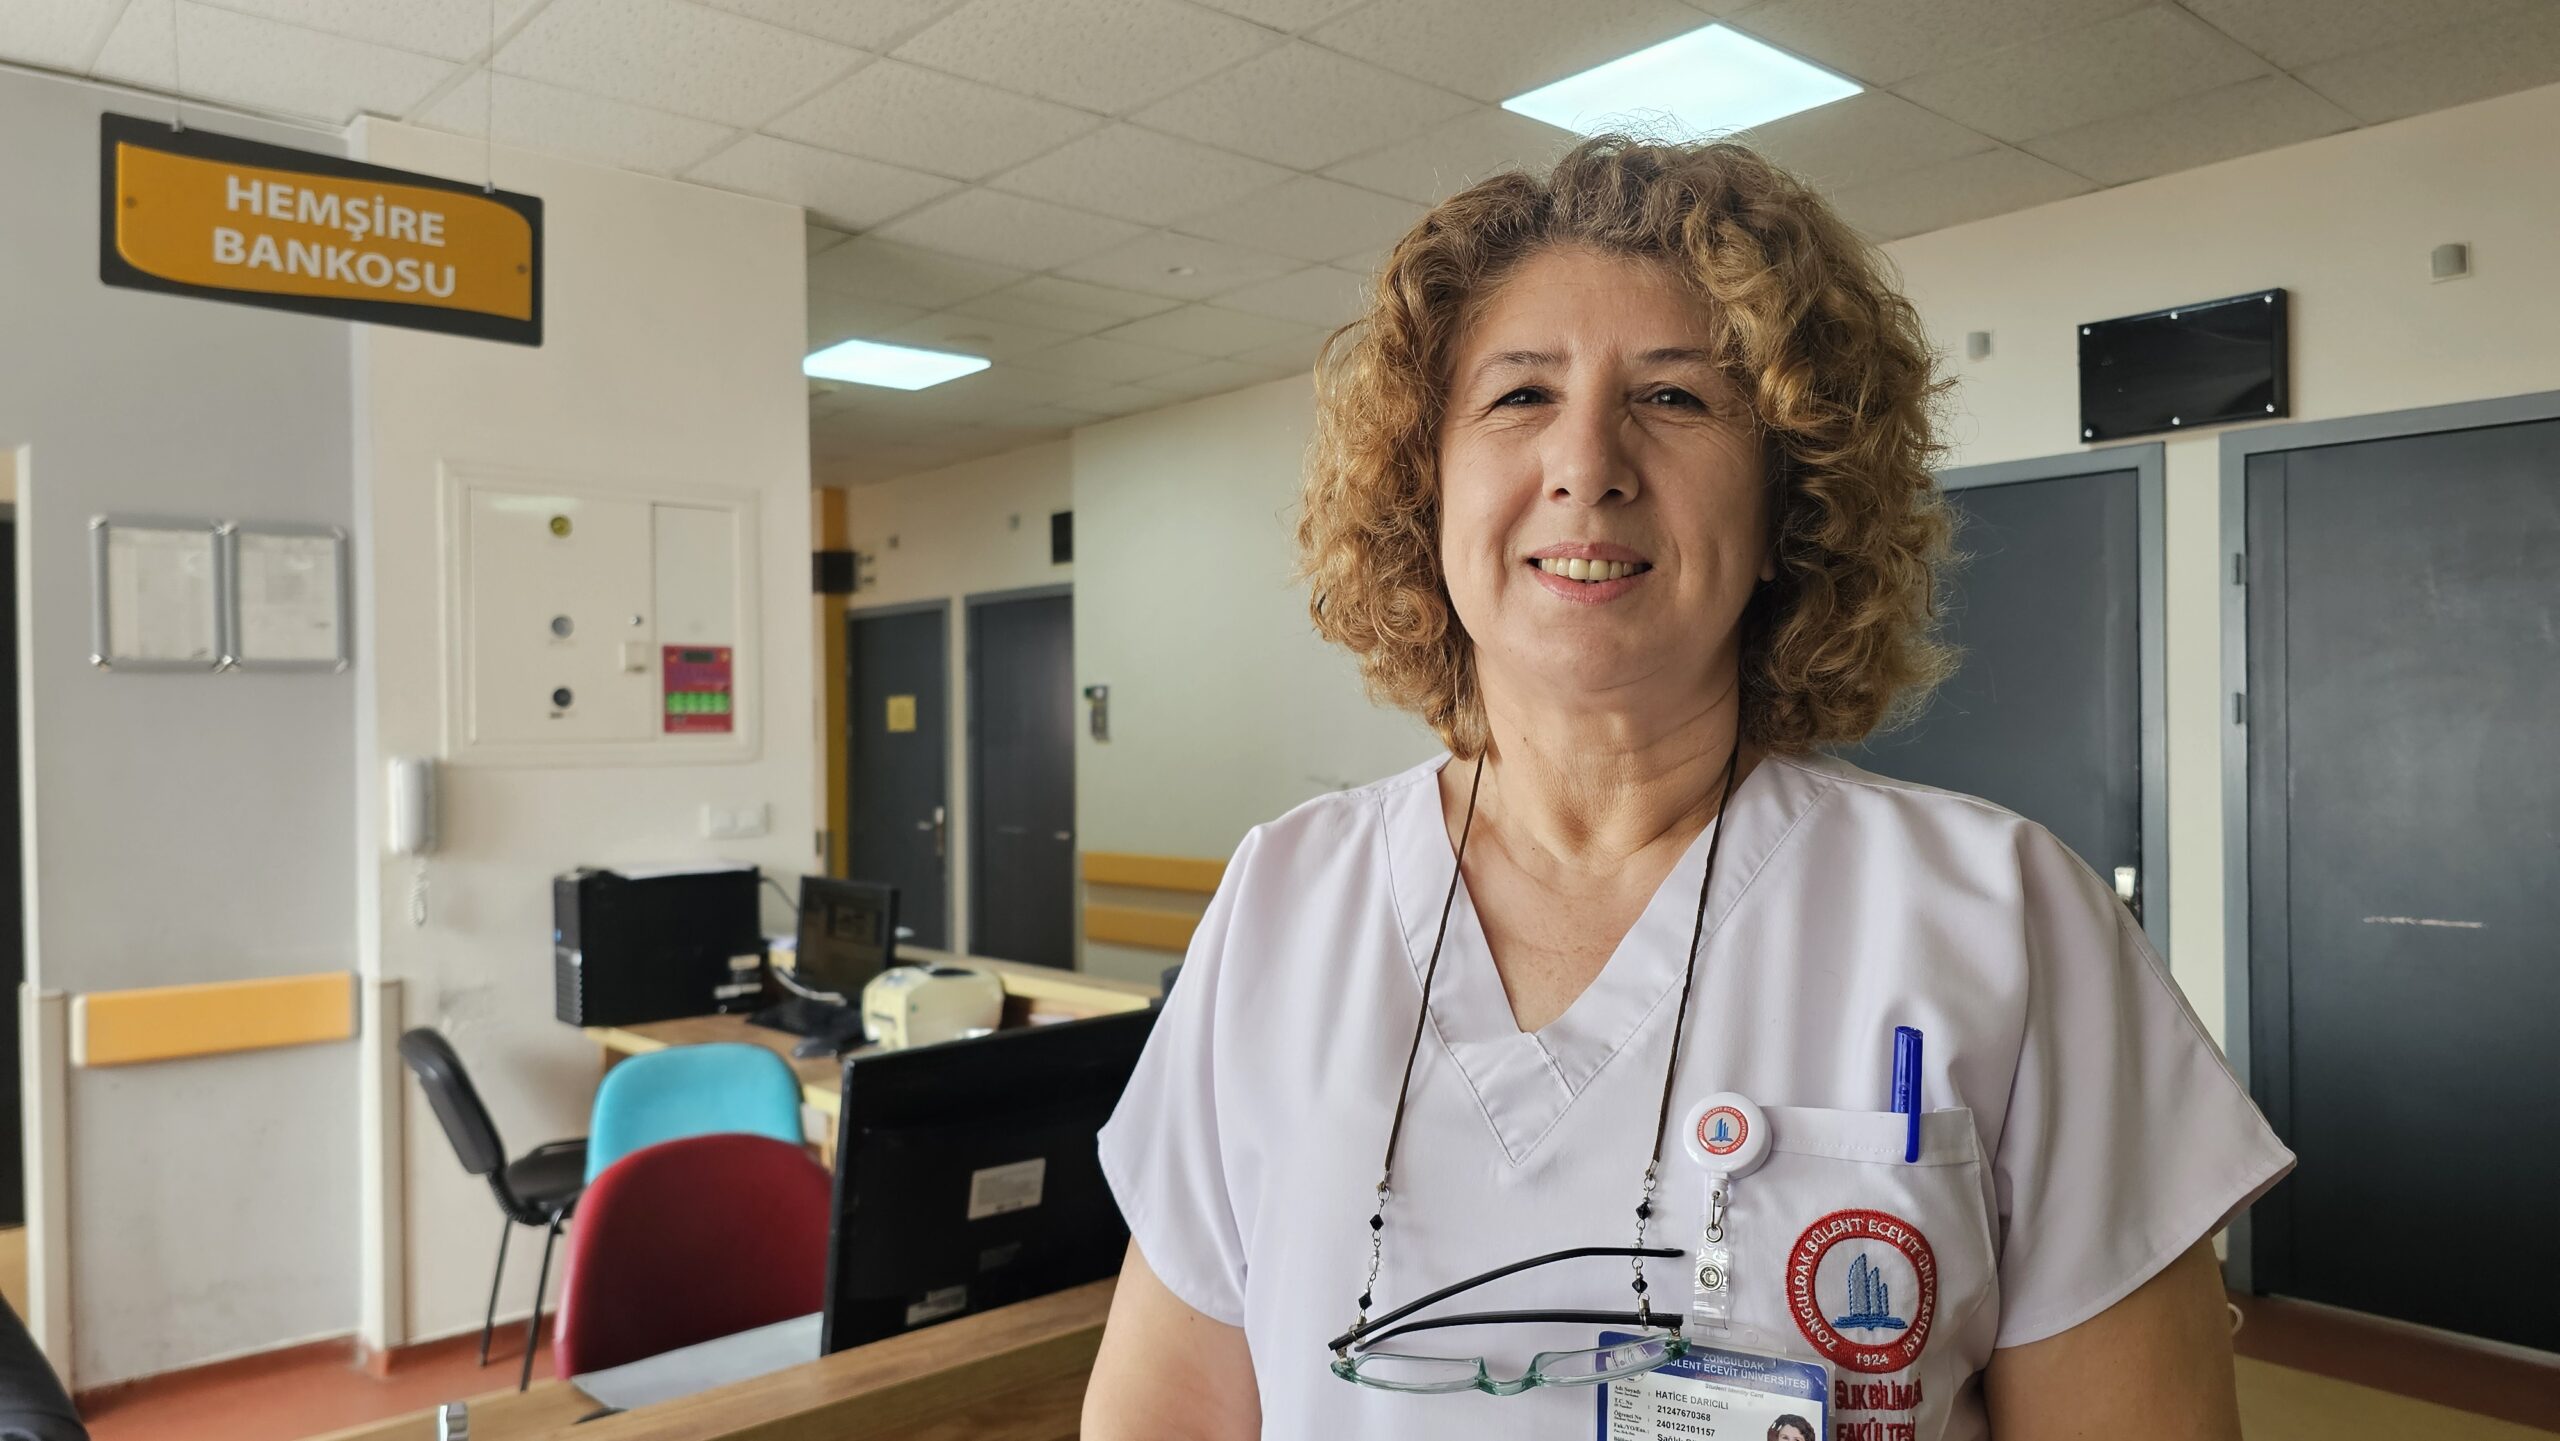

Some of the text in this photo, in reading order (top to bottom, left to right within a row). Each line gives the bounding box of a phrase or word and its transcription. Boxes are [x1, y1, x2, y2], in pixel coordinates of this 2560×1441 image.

[225, 174, 446, 247] HEMŞİRE
[212, 226, 456, 298] BANKOSU
[1794, 1253, 1838, 1352] ZONGULDAK
[1703, 1353, 1765, 1371] ZONGULDAK
[1855, 1352, 1890, 1366] 1924
[1703, 1362, 1739, 1377] ECEVİT
[1741, 1368, 1809, 1390] ÜNİVERSİTESİ
[1655, 1389, 1688, 1404] HATİCE
[1690, 1395, 1729, 1410] DARICILI
[1657, 1404, 1711, 1422] 21247670368
[1656, 1419, 1715, 1437] 240122101157
